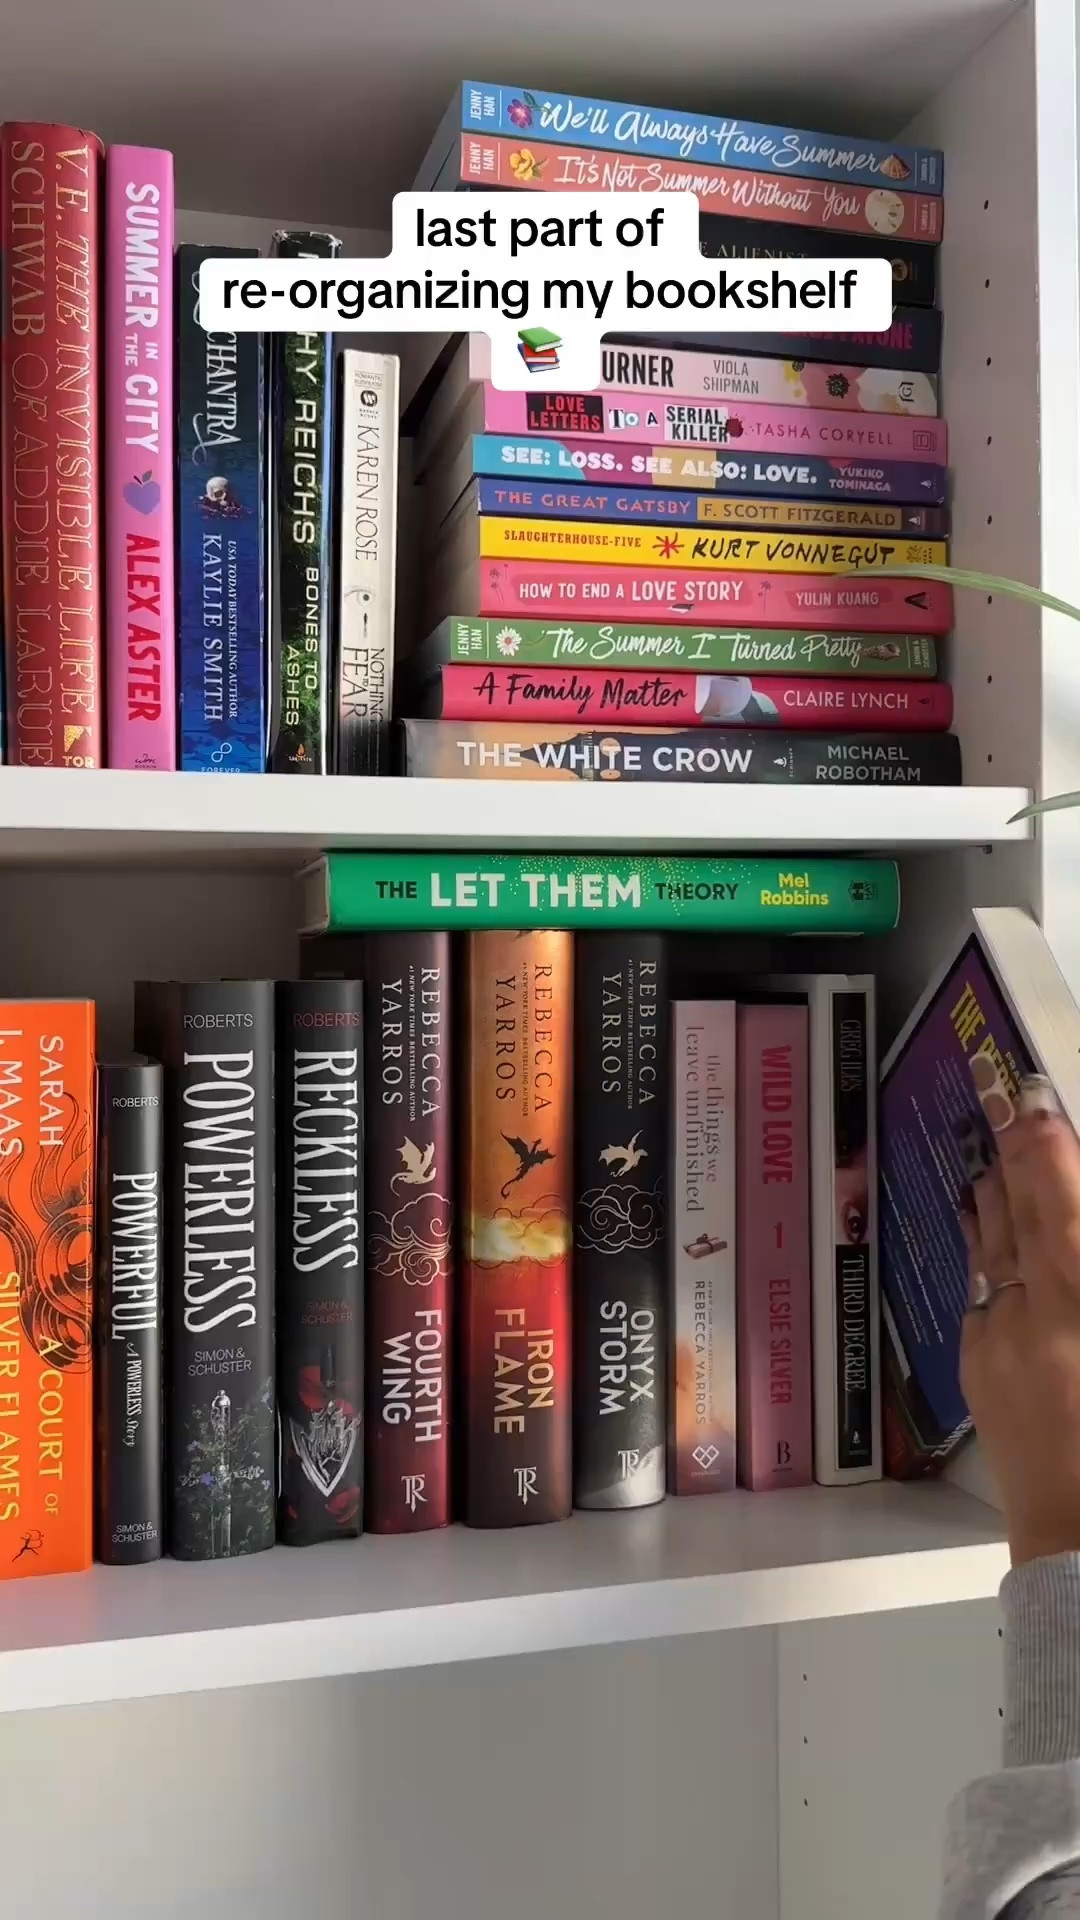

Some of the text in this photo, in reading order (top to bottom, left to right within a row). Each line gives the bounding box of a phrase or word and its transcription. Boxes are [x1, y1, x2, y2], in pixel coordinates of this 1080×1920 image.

[470, 88, 482, 120] JENNY
[483, 96, 495, 117] HAN
[470, 140, 482, 174] JENNY
[483, 147, 495, 171] HAN
[539, 99, 609, 134] We'll
[614, 110, 708, 156] Always
[708, 121, 776, 160] Have
[772, 135, 881, 174] Summer
[553, 154, 860, 221] It's Not Summer Without You
[125, 181, 160, 329] SUMMER
[124, 332, 139, 367] THE
[145, 342, 159, 361] IN
[712, 360, 750, 378] VIOLA
[125, 374, 160, 455] CITY
[545, 394, 586, 413] LOVE
[665, 406, 724, 425] SERIAL
[703, 376, 760, 395] SHIPMAN
[55, 144, 95, 714] V. E. THE INVISIBLE LIFE
[530, 411, 600, 432] LETTERS
[646, 412, 659, 427] A
[671, 422, 728, 443] KILLER
[755, 423, 894, 446] TASHA CORYELL
[11, 140, 53, 768] SCHWAB OF ADDIE LARUE
[293, 398, 318, 544] REICHS
[356, 424, 380, 501] KAREN
[501, 445, 818, 484] SEE: LOSS. SEE ALSO: LOVE.
[838, 466, 885, 481] YUKIKO
[494, 490, 896, 527] THE GREAT GATSBY F. SCOTT FITZGERALD
[828, 478, 892, 493] TOMINAGA
[354, 506, 378, 561] ROSE
[503, 528, 642, 548] SLAUGHTERHOUSE-FIVE
[692, 536, 895, 567] KURT VONNEGUT
[126, 533, 161, 616] ALEX
[519, 580, 744, 601] HOW TO END A LOVE STORY
[795, 591, 880, 607] YULIN KUANG
[203, 533, 222, 720] KAYLIE SMITH
[228, 540, 238, 718] USA TODAY BESTSELLING AUTHOR
[305, 567, 319, 689] BONES TO
[456, 623, 470, 656] JENNY
[471, 627, 484, 650] HAN
[541, 626, 865, 668] The Summer I Turned Pretty
[127, 622, 162, 721] ASTER
[286, 645, 300, 726] ASHES
[342, 646, 369, 719] FEAR
[473, 671, 688, 715] A Family Matter
[783, 690, 909, 709] CLAIRE LYNCH
[457, 741, 522, 767] THE
[532, 741, 641, 772] WHITE
[652, 746, 753, 773] CROW
[815, 765, 921, 781] ROBOTHAM
[826, 745, 910, 761] MICHAEL
[374, 872, 740, 909] THE LET THEM THEORY
[760, 889, 830, 906] Robbins
[778, 872, 810, 889] Mel
[183, 1013, 254, 1030] ROBERTS
[292, 1012, 361, 1030] ROBERTS
[382, 978, 403, 1106] YARROS
[421, 966, 441, 1117] REBECCA
[495, 975, 516, 1101] YARROS
[534, 963, 553, 1113] REBECCA
[602, 972, 622, 1093] YARROS
[639, 960, 657, 1105] REBECCA
[0, 1060, 24, 1156] MAAS
[39, 1034, 65, 1147] SARAH
[112, 1095, 160, 1107] ROBERTS
[685, 1026, 705, 1212] leave unfinished
[703, 1055, 725, 1183] the things we
[762, 1044, 793, 1185] WILD LOVE
[183, 1048, 256, 1334] POWERLESS
[292, 1048, 360, 1273] RECKLESS
[111, 1171, 159, 1341] POWERFUL
[773, 1221, 783, 1249] 1
[694, 1280, 706, 1426] REBECCA YARROS
[769, 1279, 793, 1405] ELSIE SILVER
[843, 1254, 867, 1393] THIRD DEGREE
[187, 1359, 252, 1377] SCHUSTER
[194, 1346, 246, 1364] SIMON &
[382, 1331, 412, 1425] WING
[414, 1308, 442, 1442] FOURTH
[494, 1308, 526, 1434] FLAME
[527, 1328, 555, 1409] IRON
[599, 1300, 628, 1416] STORM
[629, 1308, 655, 1402] ONYX
[38, 1333, 64, 1517] A COURT OF
[122, 1359, 142, 1448] POWERLESS Story
